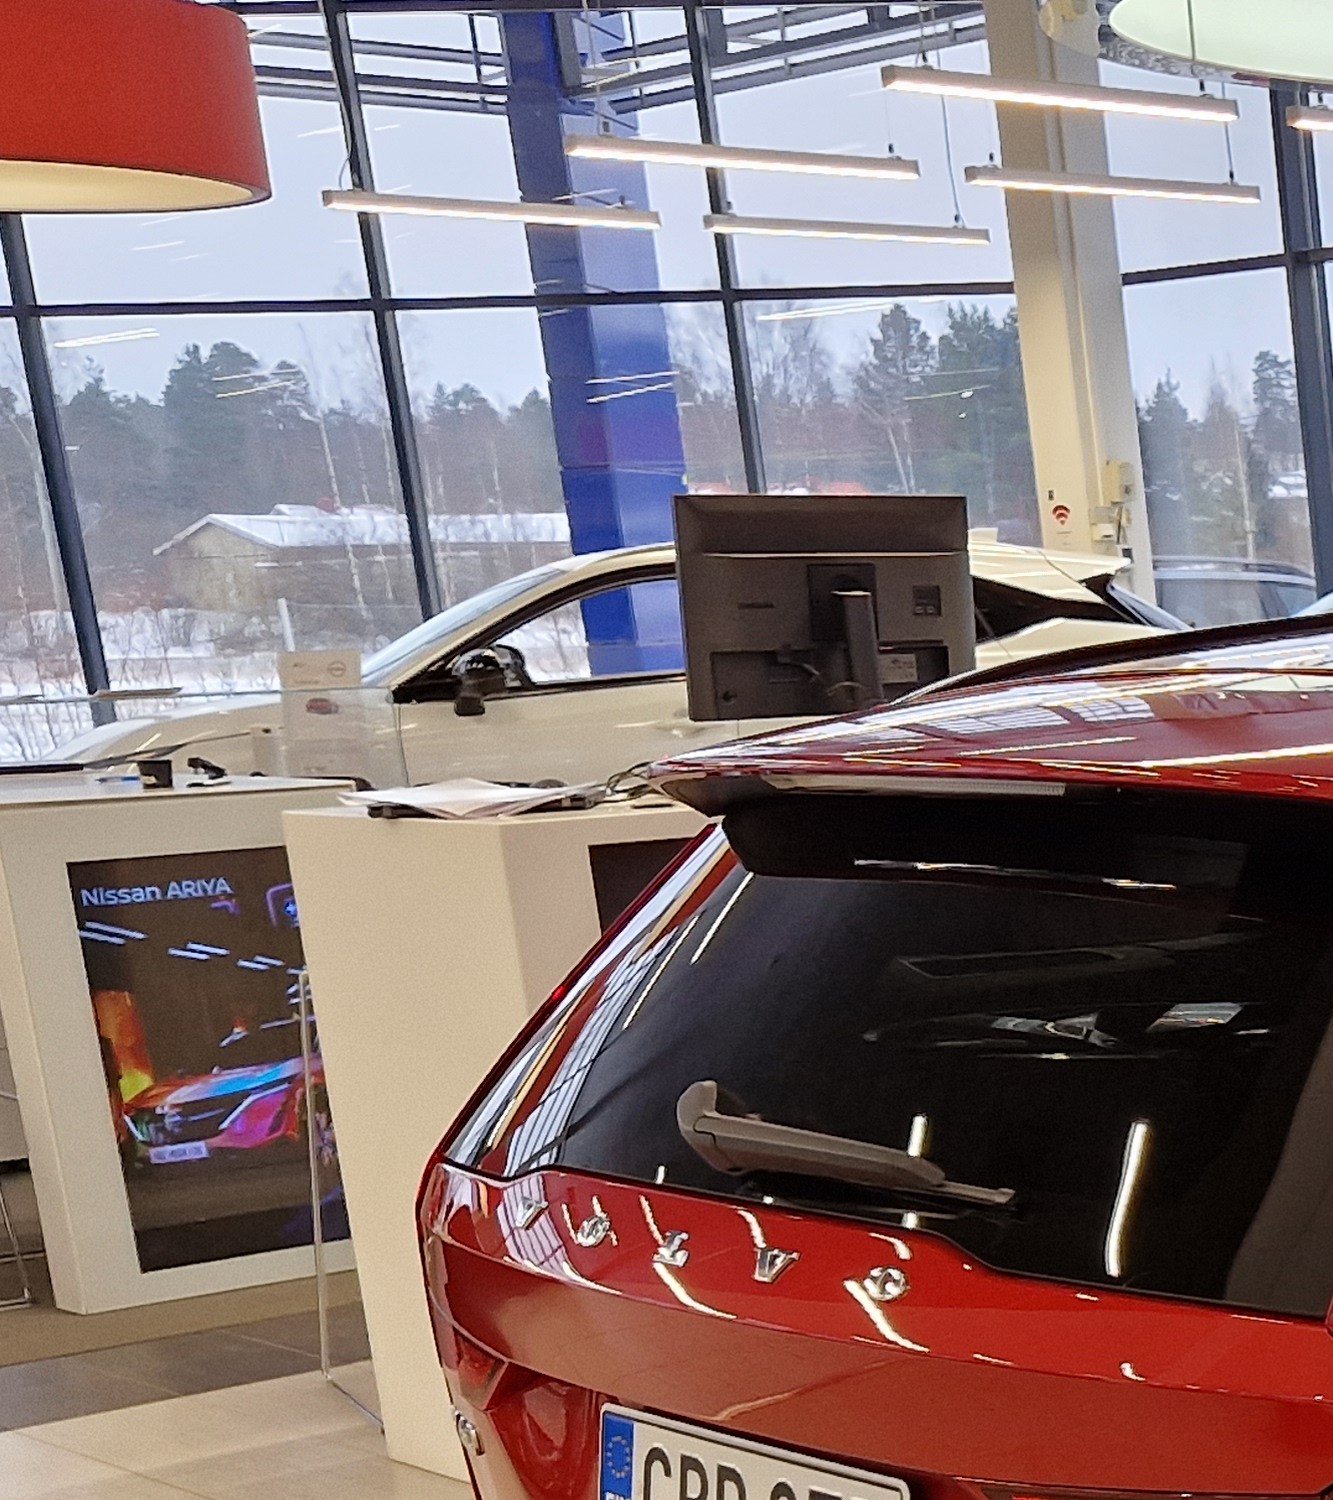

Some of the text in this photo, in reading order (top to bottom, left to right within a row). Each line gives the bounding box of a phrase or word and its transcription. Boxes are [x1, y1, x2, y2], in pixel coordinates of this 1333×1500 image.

[80, 876, 235, 907] Nissan ARIYA
[514, 1195, 909, 1302] VOLVO
